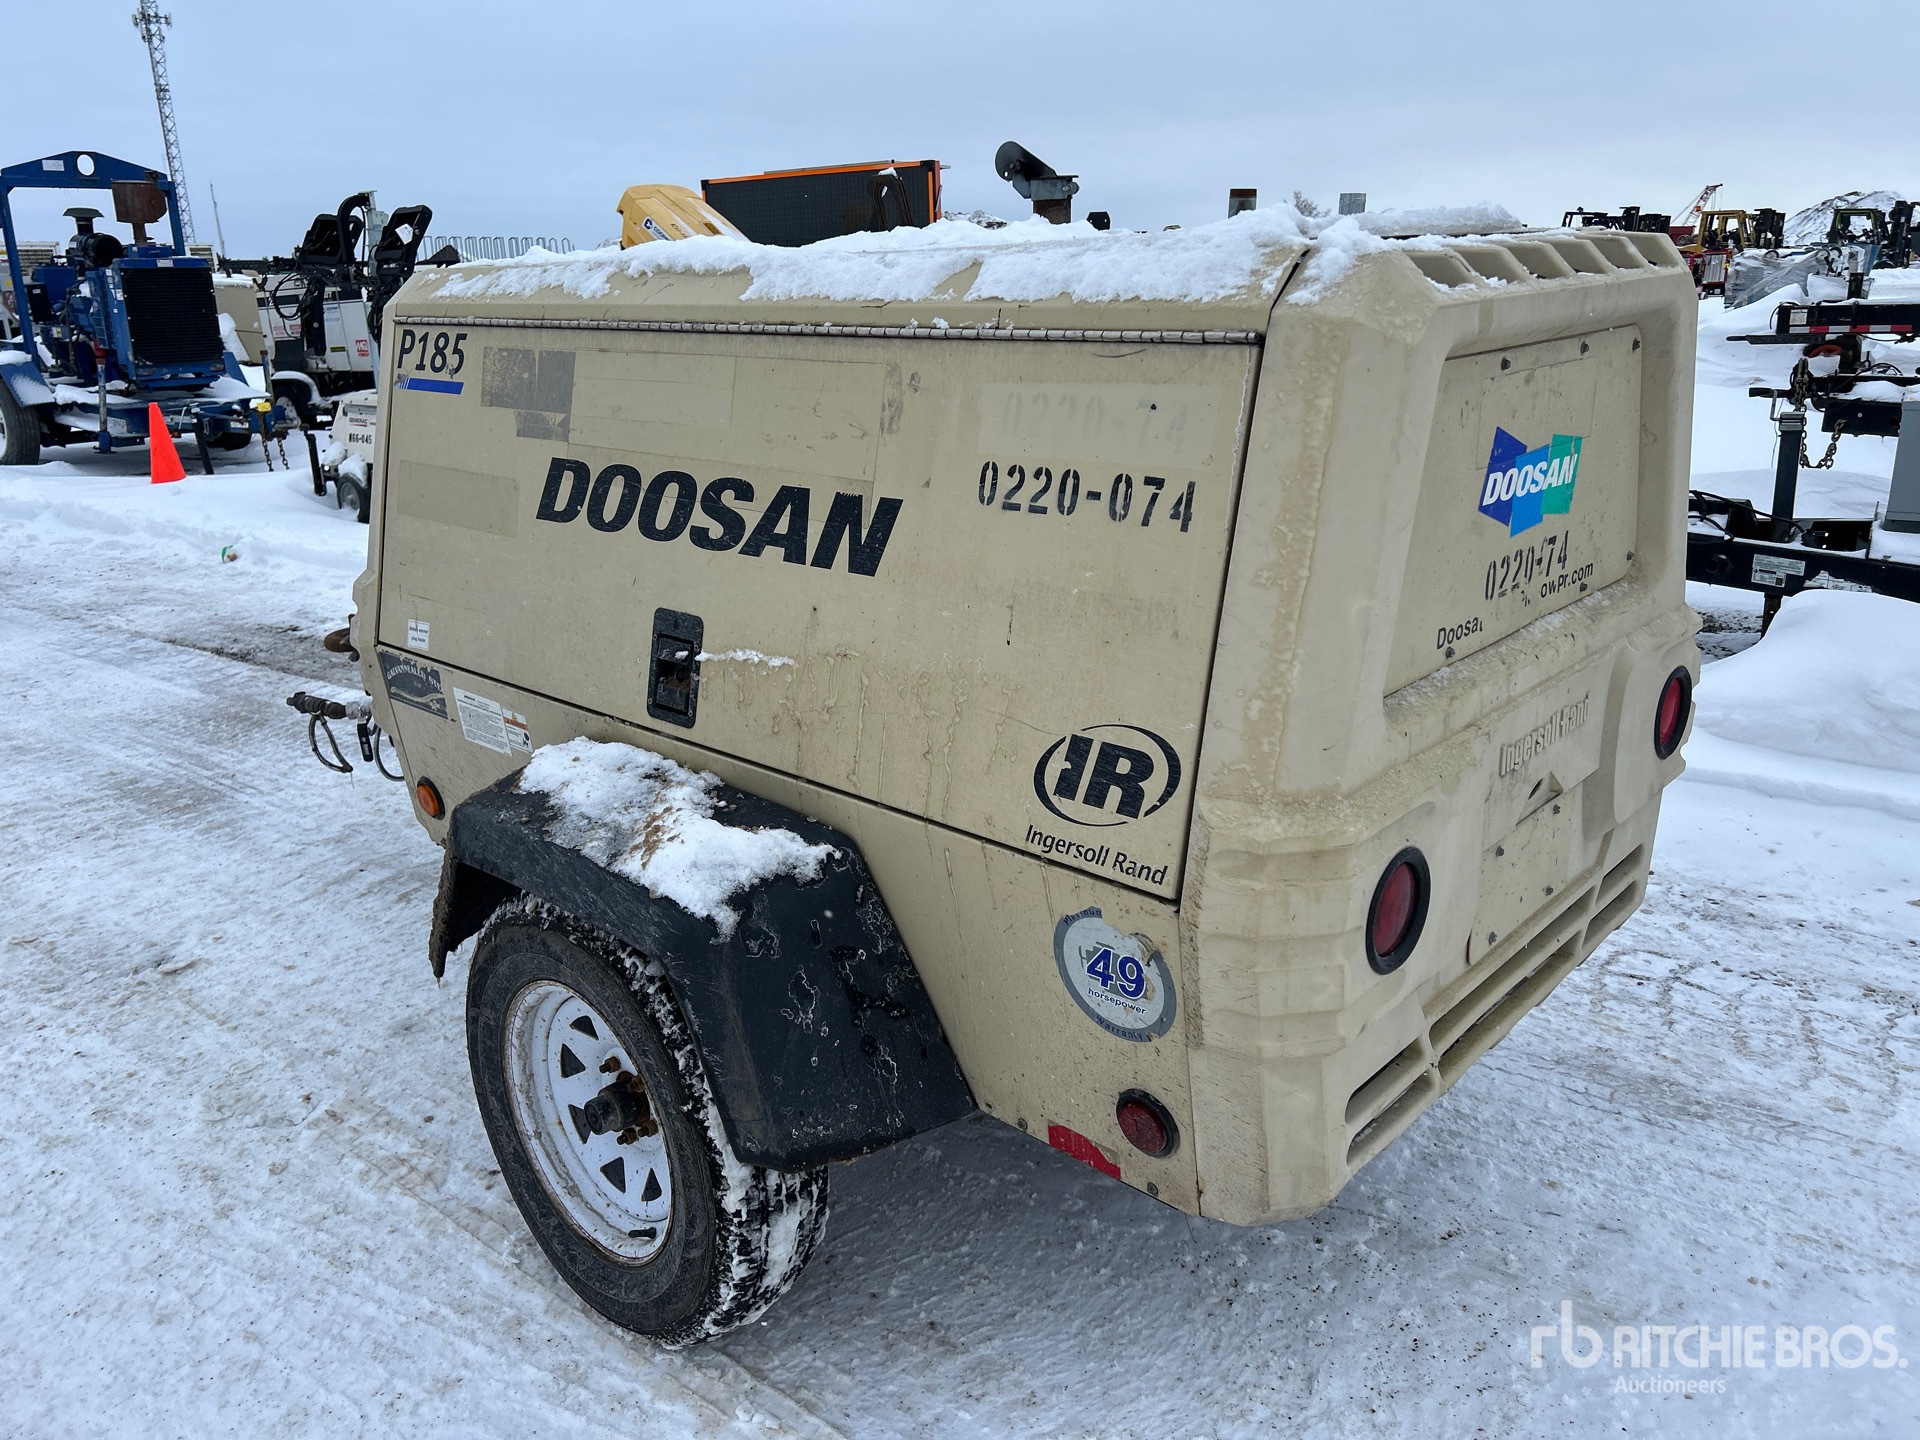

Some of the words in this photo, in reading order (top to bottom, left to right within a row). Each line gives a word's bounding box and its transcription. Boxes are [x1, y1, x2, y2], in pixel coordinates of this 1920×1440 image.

[397, 328, 468, 376] P185
[978, 460, 1196, 533] 0220-074
[1481, 453, 1578, 507] DOOSAN
[535, 457, 904, 577] DOOSAN
[1052, 733, 1155, 820] IR
[1025, 824, 1110, 867] Ingersoll
[1111, 850, 1169, 886] Rand
[1086, 947, 1147, 1000] 49
[1088, 987, 1147, 1015] horsepower
